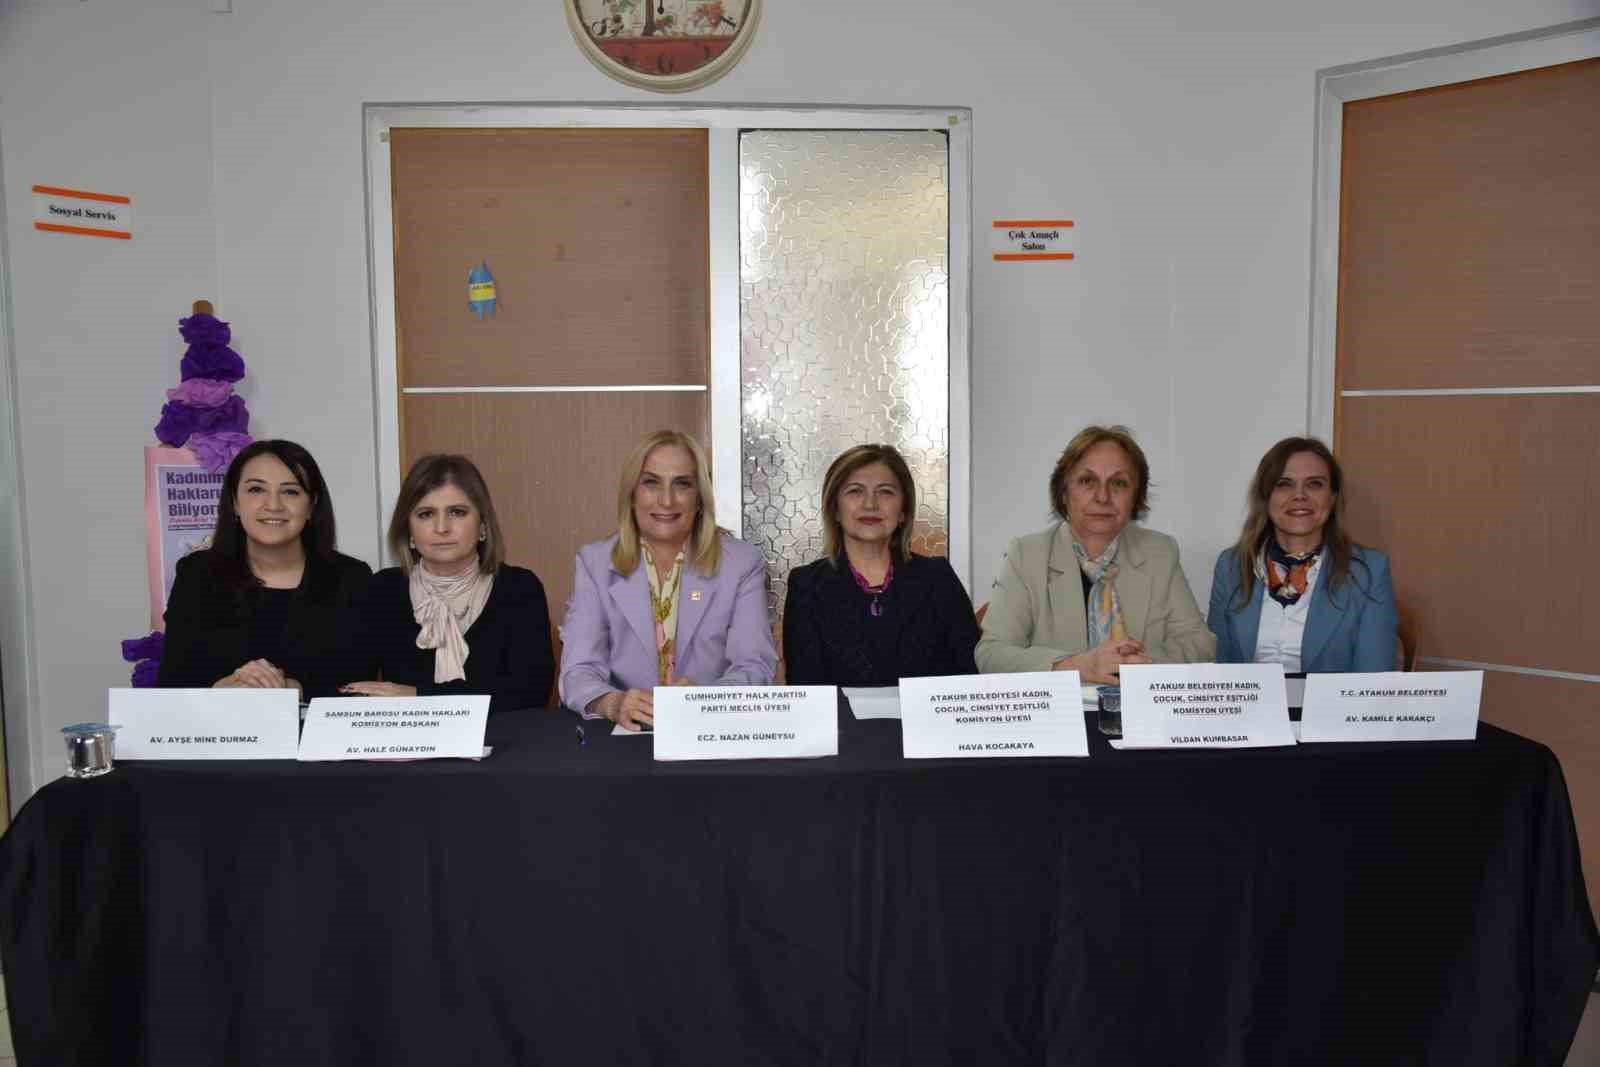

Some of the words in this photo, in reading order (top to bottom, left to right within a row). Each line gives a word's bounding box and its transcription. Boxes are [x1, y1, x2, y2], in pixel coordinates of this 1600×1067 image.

[49, 205, 82, 217] Sosyal
[85, 209, 116, 220] Servis
[1008, 230, 1026, 240] Çok
[1022, 242, 1046, 250] Salon
[1150, 682, 1186, 690] ATAKUM
[1234, 681, 1261, 690] KADIN,
[746, 692, 769, 700] HALK
[930, 694, 968, 702] ATAKUM
[1022, 690, 1052, 698] KADIN,
[1153, 695, 1186, 704] ÇOCUK,
[935, 706, 968, 714] ÇOCUK,
[150, 736, 165, 744] AV.
[168, 736, 192, 744] AYŞE
[194, 736, 217, 744] MİNE
[697, 734, 718, 742] ECZ.
[752, 732, 796, 740] GÜNEYSU
[346, 746, 360, 754] AV.
[959, 743, 983, 751] HAVA
[986, 742, 1034, 750] KOCAKAYA
